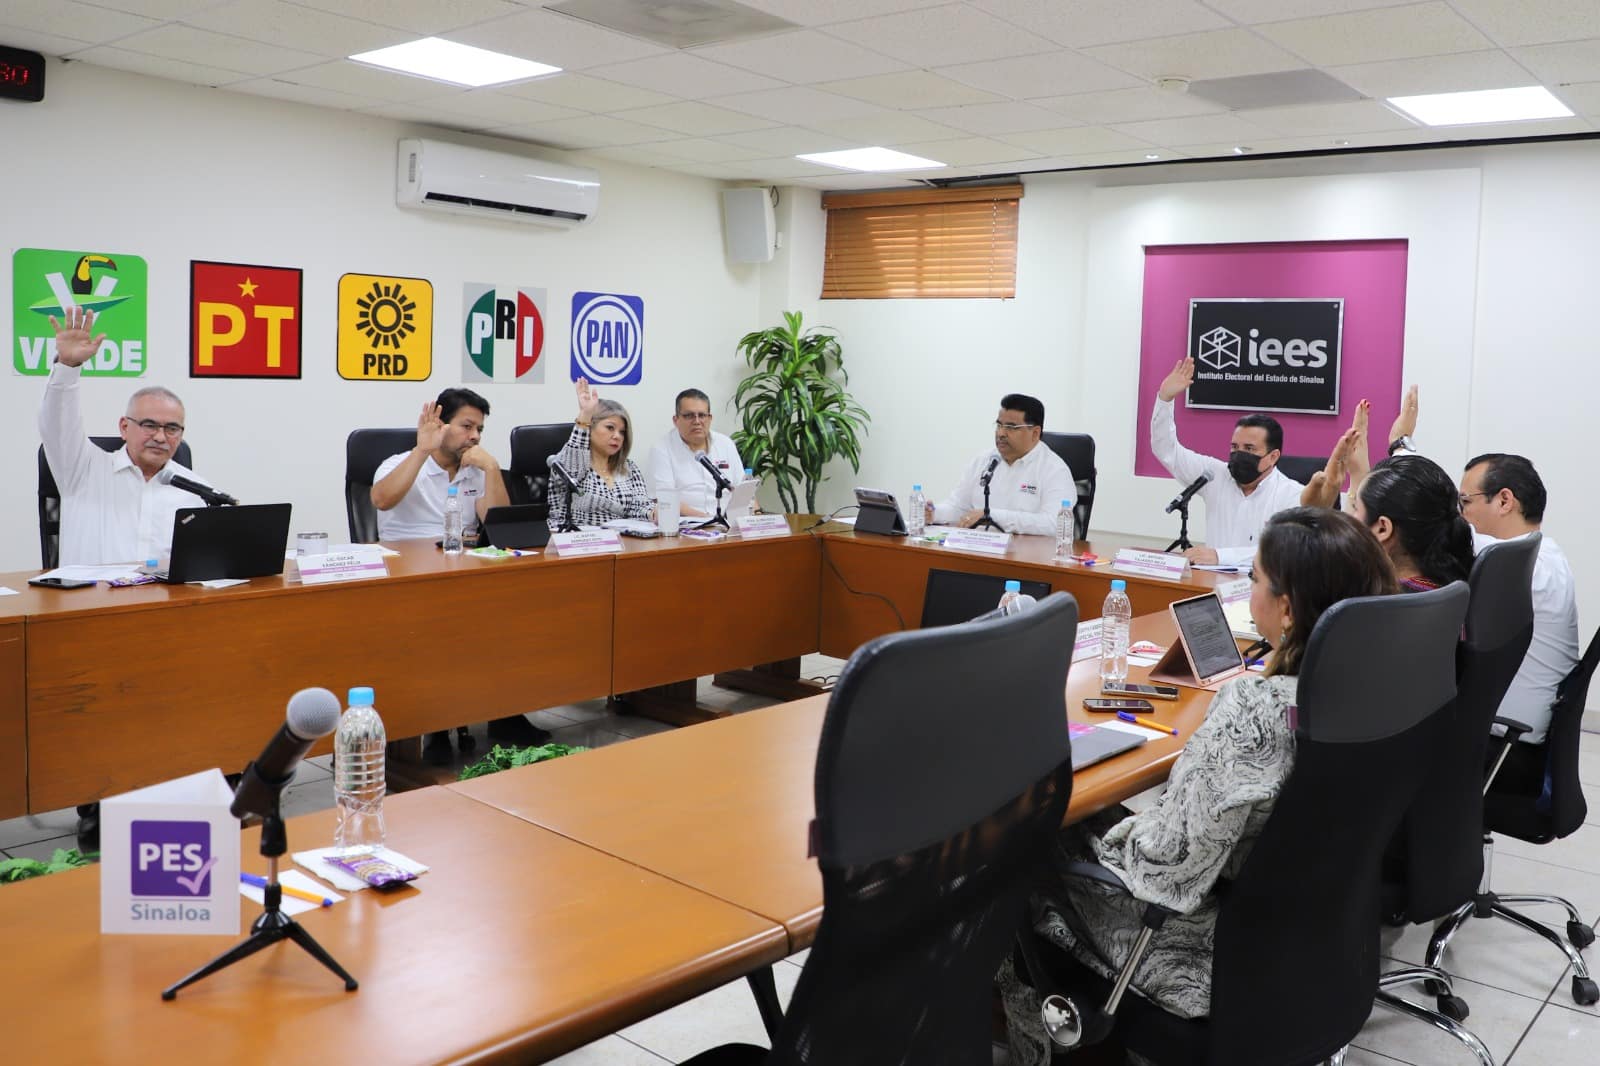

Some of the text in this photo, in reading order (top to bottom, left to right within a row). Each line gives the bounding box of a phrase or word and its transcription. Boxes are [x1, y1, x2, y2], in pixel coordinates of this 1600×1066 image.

[199, 302, 294, 368] PT
[471, 299, 535, 357] PRI
[586, 319, 629, 359] PAN
[363, 353, 408, 376] PRD
[1248, 328, 1328, 368] iees
[1198, 371, 1325, 384] Instituto Electoral del Estado de Sinaloa
[138, 842, 204, 872] PES
[130, 903, 211, 921] Sinaloa
